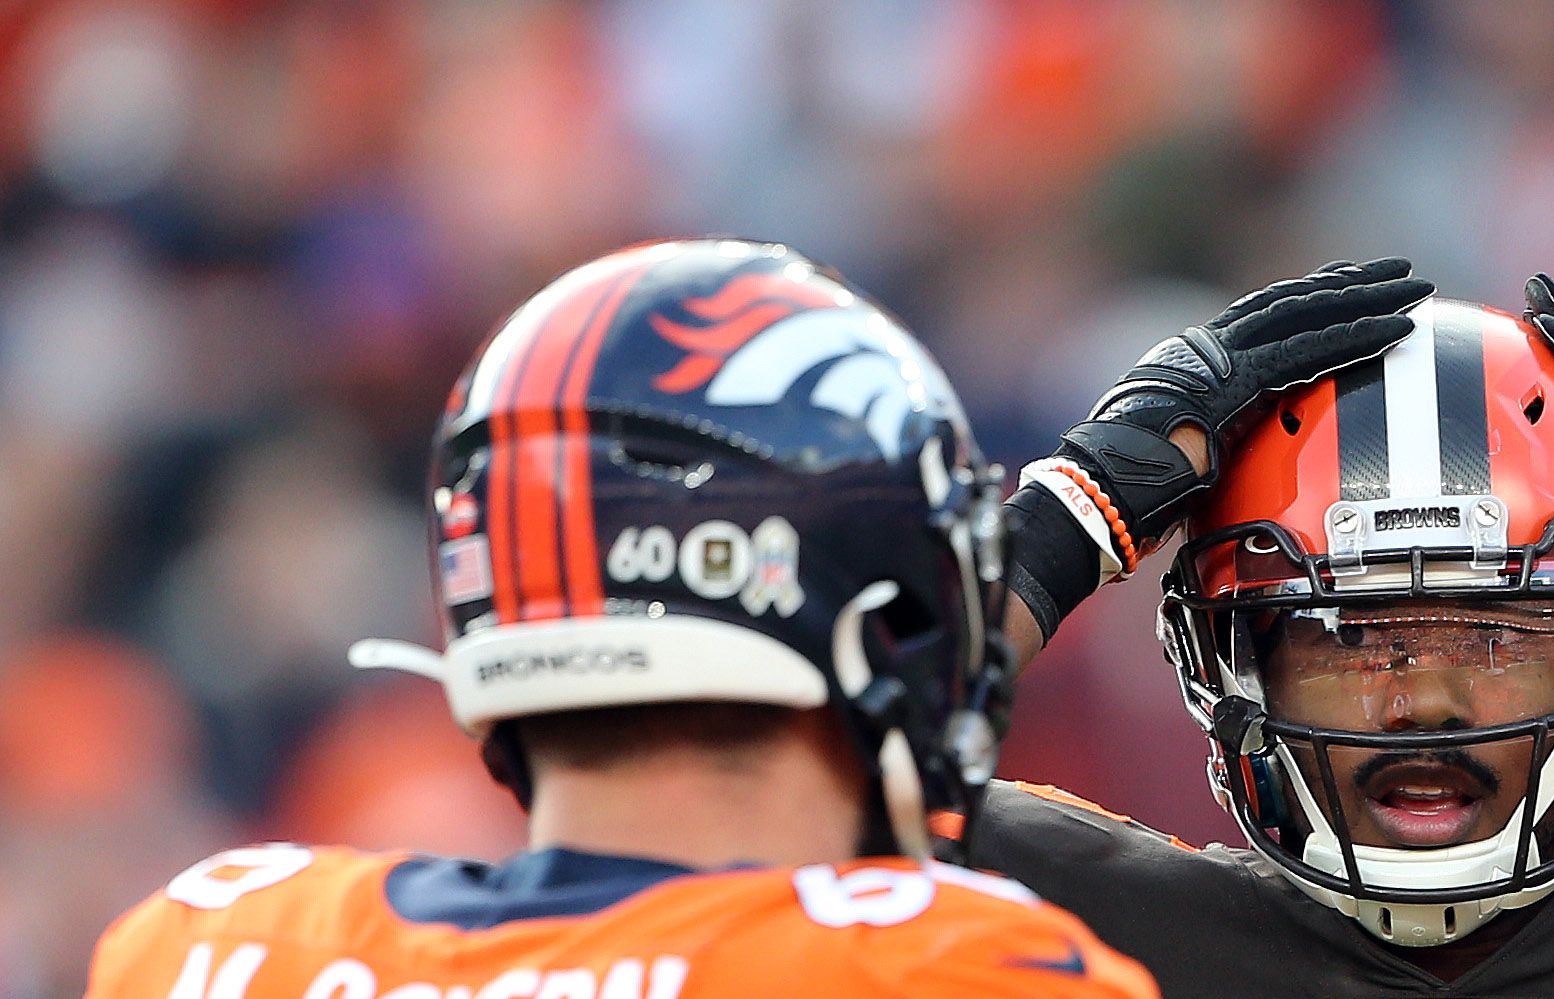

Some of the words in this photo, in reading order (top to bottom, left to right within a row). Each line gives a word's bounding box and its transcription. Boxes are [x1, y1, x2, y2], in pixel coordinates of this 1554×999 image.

[1061, 485, 1093, 516] ALS
[1375, 506, 1460, 532] BROWNS
[606, 524, 677, 583] 60
